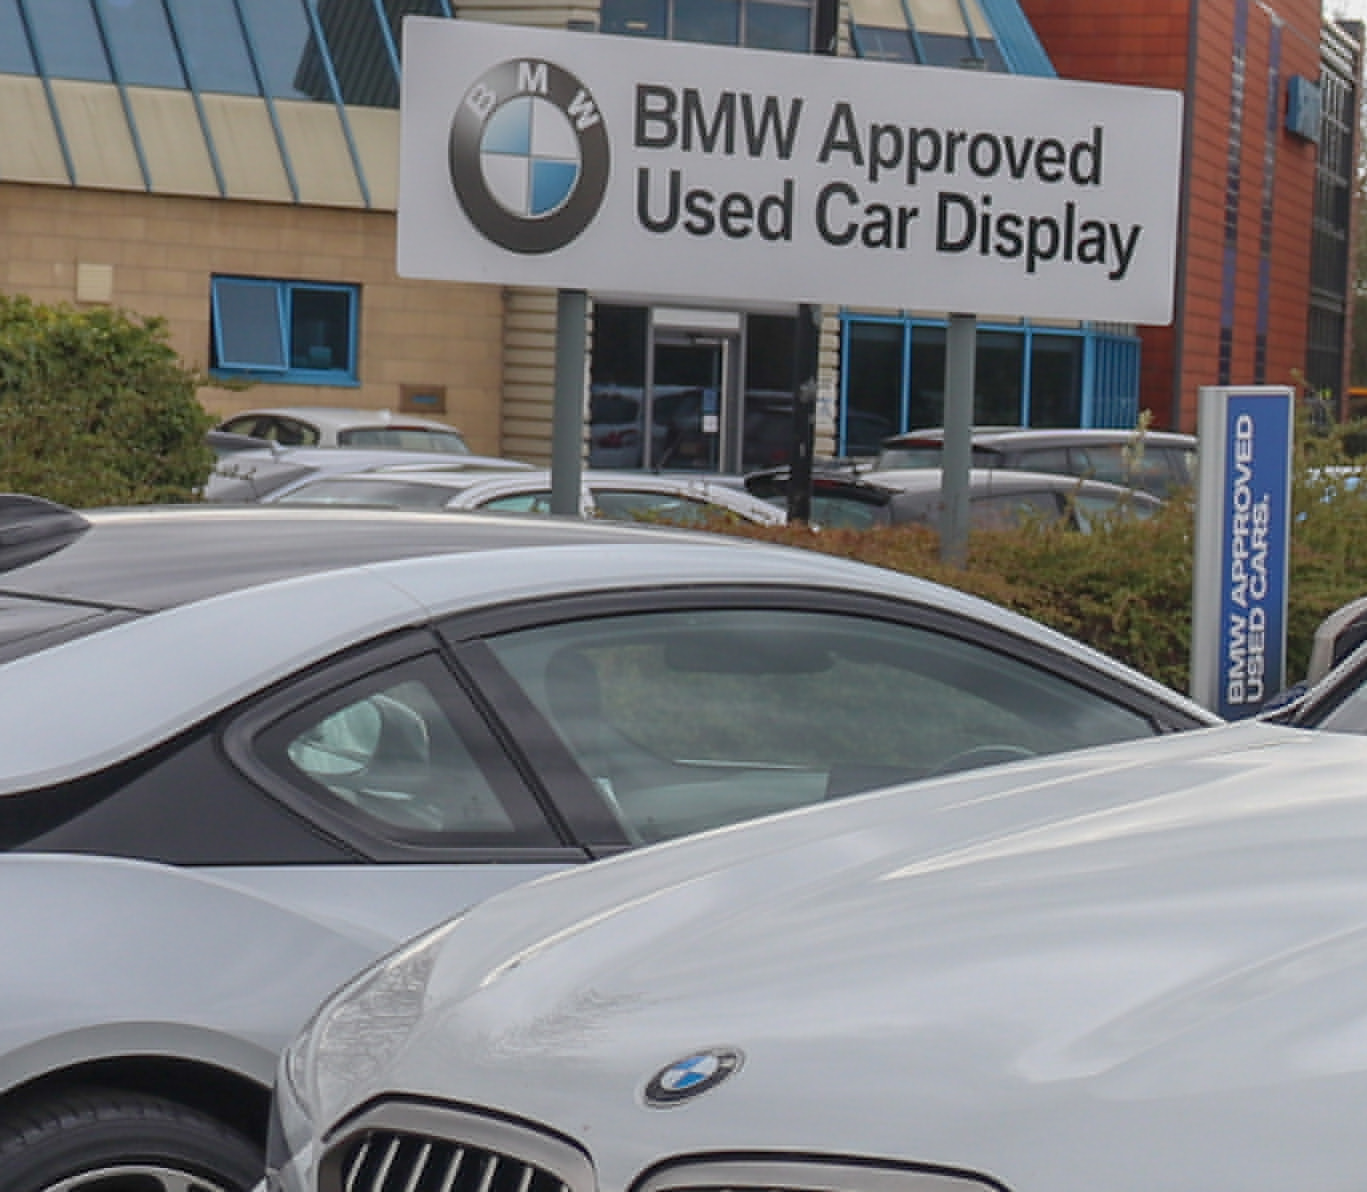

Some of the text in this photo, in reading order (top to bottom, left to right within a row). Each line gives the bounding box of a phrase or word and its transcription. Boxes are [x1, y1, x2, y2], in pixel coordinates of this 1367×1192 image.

[465, 61, 600, 130] BMW
[635, 84, 1104, 186] BMW Approved
[637, 167, 1143, 281] Used Car Display
[1227, 414, 1255, 706] BMW APPROVED
[1247, 493, 1271, 703] USED CARS.
